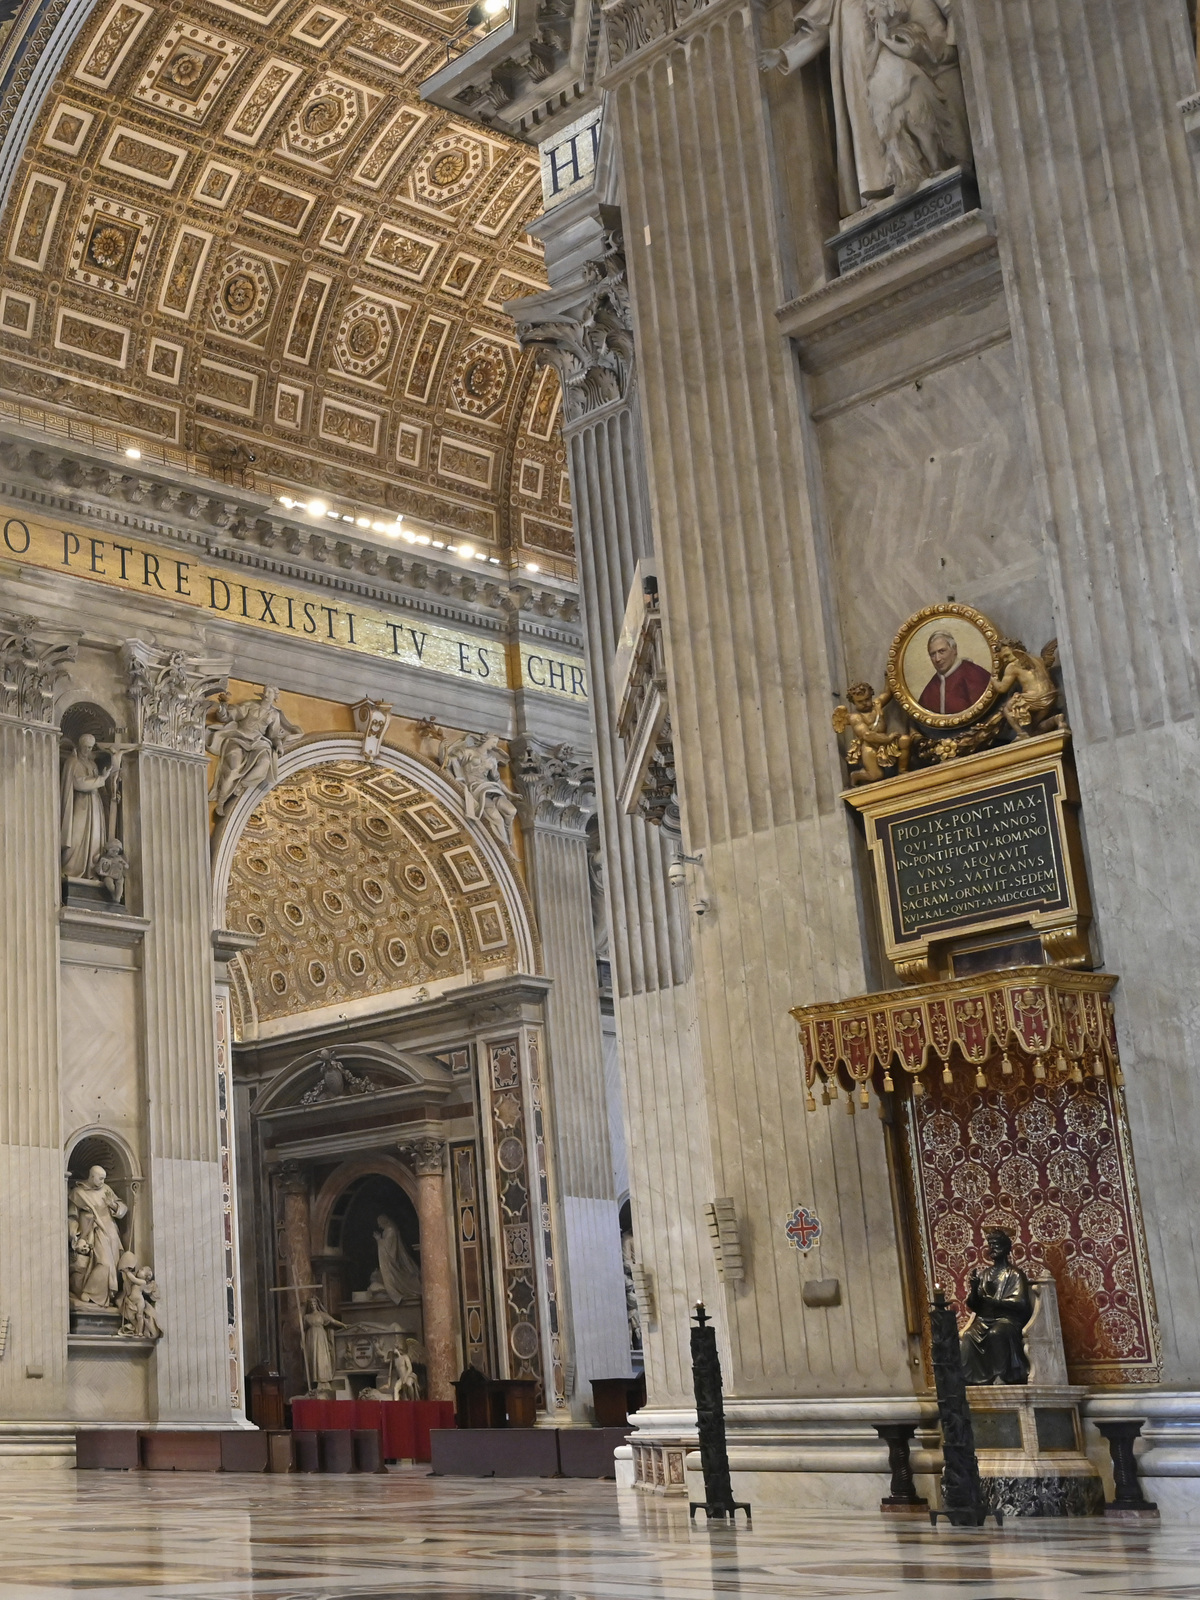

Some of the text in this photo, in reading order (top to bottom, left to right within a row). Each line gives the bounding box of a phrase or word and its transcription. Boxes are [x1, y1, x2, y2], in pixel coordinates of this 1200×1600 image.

[857, 218, 907, 250] JOANNES
[914, 193, 953, 221] BOSCO
[3, 518, 31, 554] O
[61, 530, 193, 598] PETRE
[207, 576, 357, 645] DIXISTI
[386, 620, 429, 660] TV
[458, 642, 490, 679] ES
[897, 794, 1036, 841] PIO IX PONT MAX
[904, 813, 1037, 856] QVI PETRI ANNOS
[897, 825, 1047, 871] IN PONTIFICATV ROMANO
[918, 845, 1029, 879] VNVS AEQVAVIT
[902, 868, 1054, 912] SACRAM ORNAVIT SEDEM
[906, 855, 1045, 897] CLERVS VATICANVS
[904, 883, 1056, 924] XVI KAL QVINT A MDCCCLXXI
